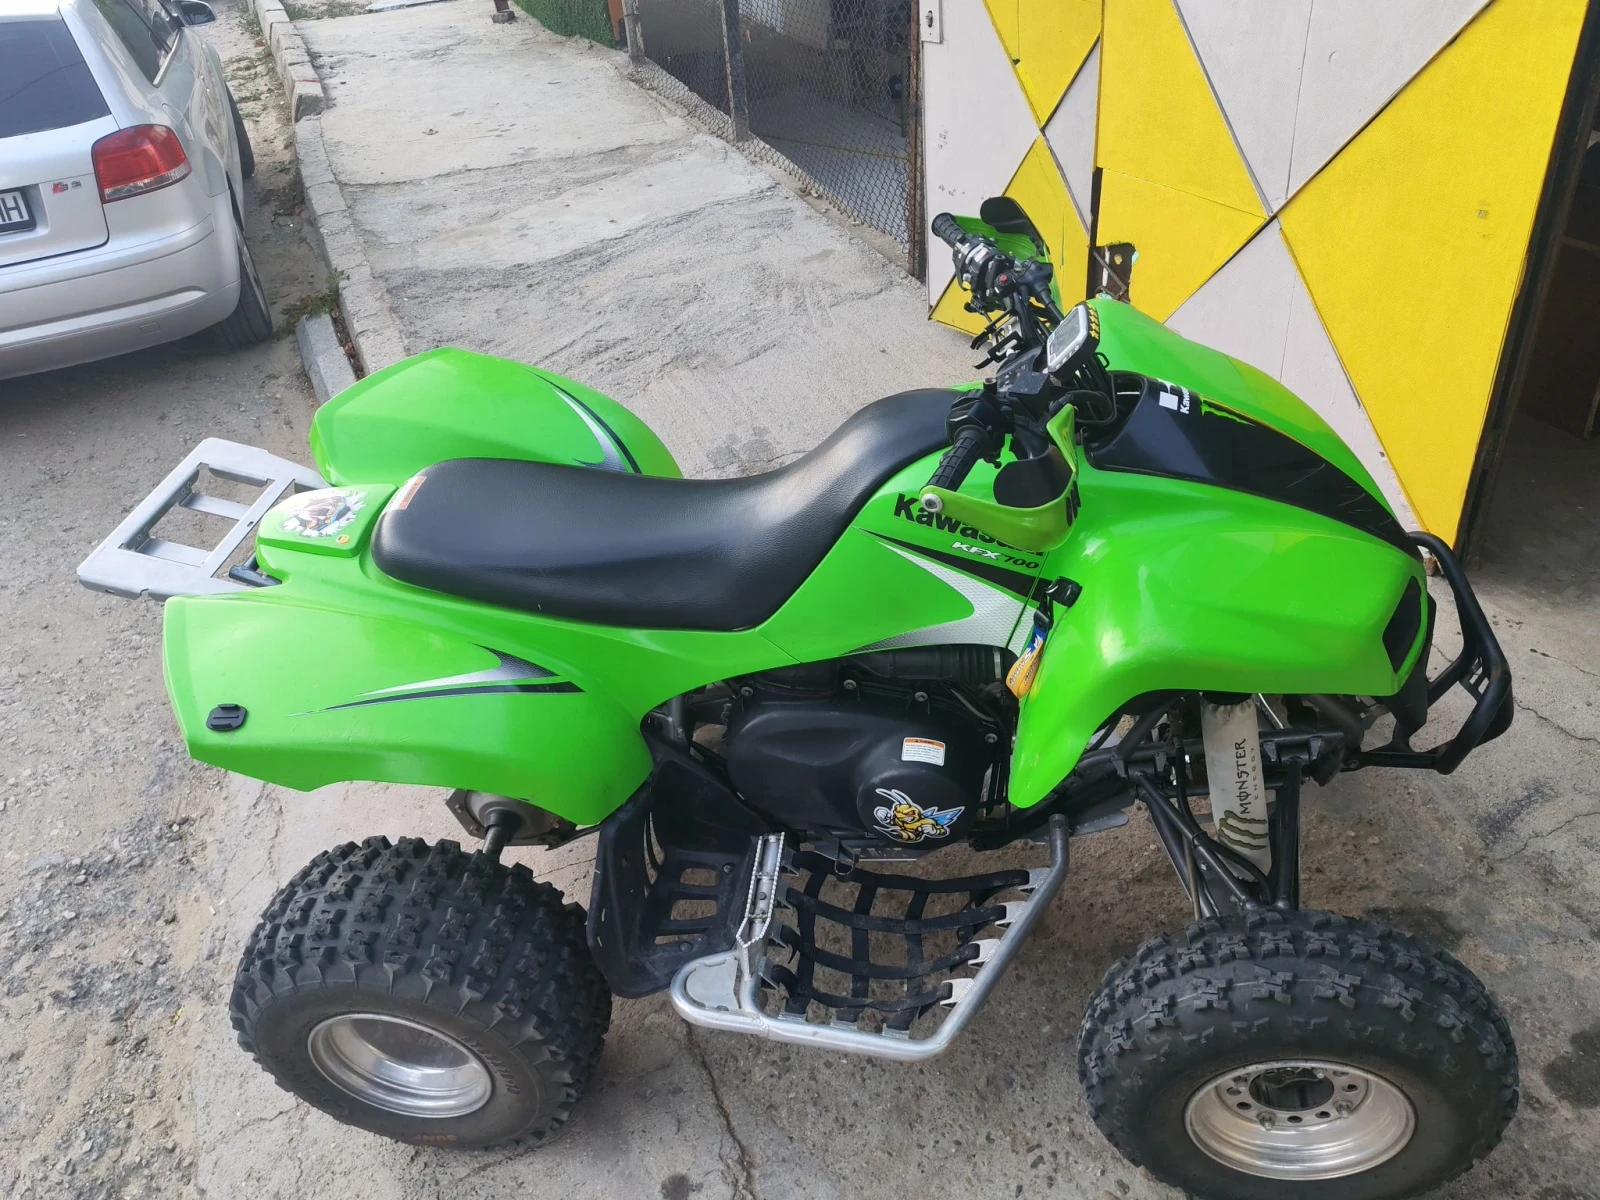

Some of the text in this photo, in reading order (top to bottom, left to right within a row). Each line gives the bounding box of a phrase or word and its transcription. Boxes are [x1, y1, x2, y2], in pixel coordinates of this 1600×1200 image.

[952, 541, 1040, 569] KFX 700
[1235, 738, 1251, 815] MONSTER
